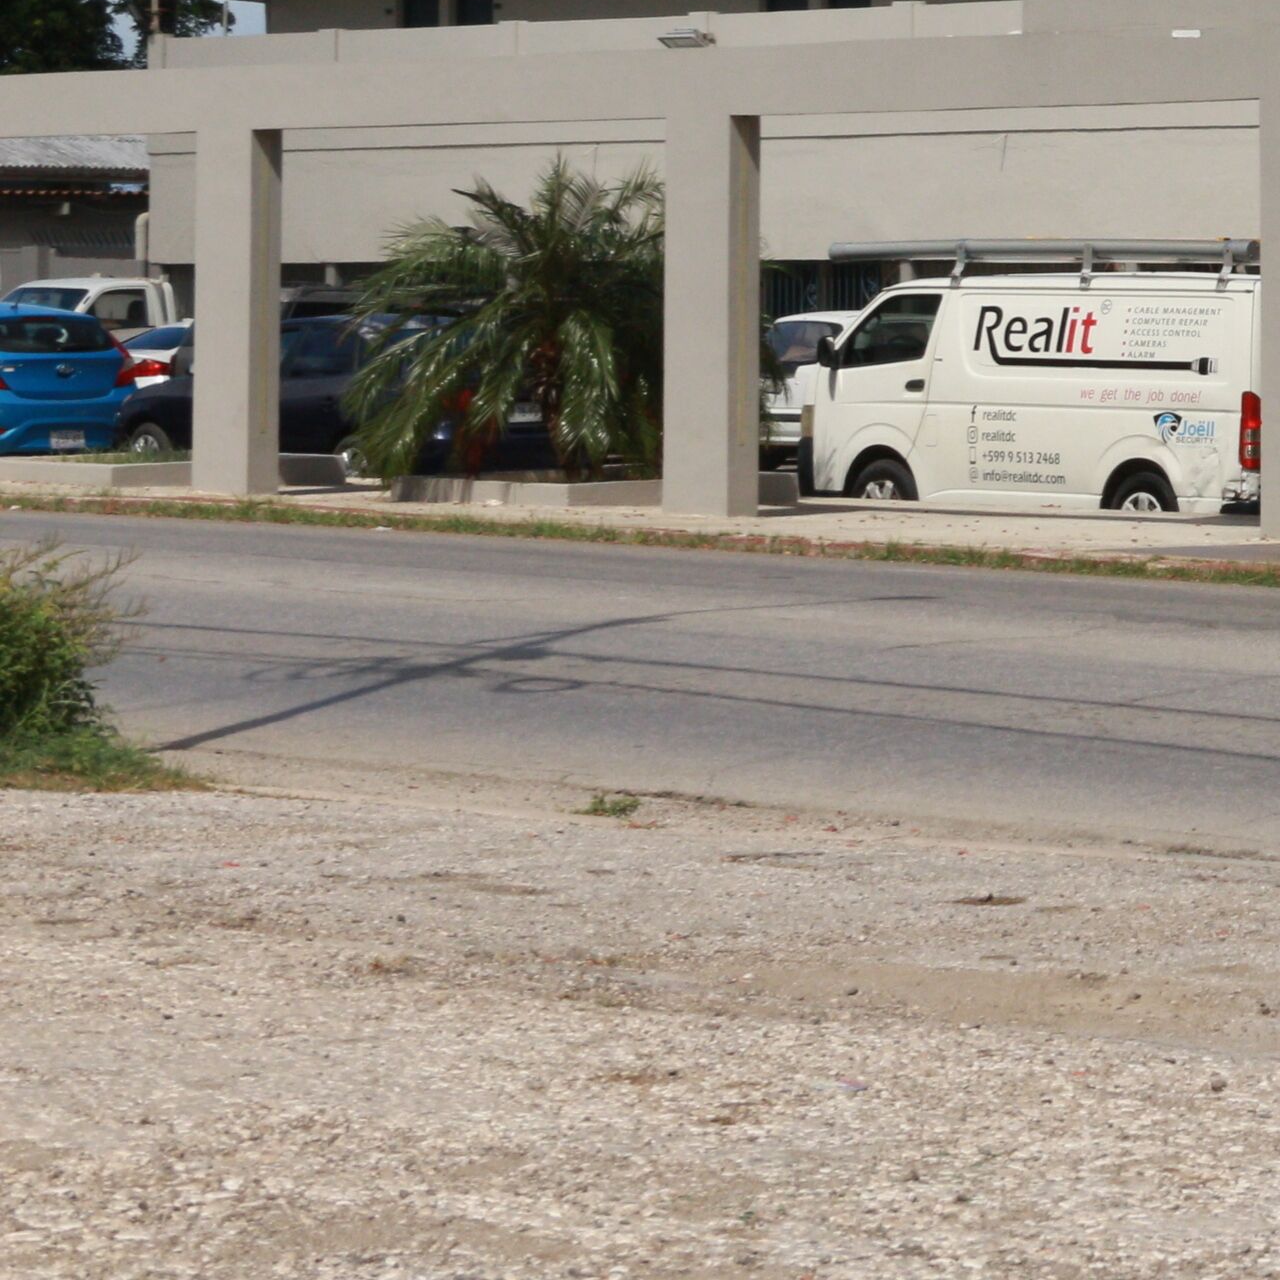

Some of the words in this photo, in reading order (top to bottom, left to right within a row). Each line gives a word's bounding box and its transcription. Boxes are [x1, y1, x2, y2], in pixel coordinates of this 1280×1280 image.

[1134, 306, 1160, 315] CABLE
[1162, 307, 1223, 316] MANAGEMENT
[1131, 317, 1177, 326] COMPUTER
[1178, 318, 1209, 327] REPAIR
[972, 305, 1098, 355] Realit
[1129, 328, 1160, 337] ACCESS
[1162, 329, 1202, 338] CONTROL
[1128, 339, 1168, 348] CAMERAS
[1126, 350, 1156, 359] ALARM
[1080, 388, 1095, 400] we
[1099, 387, 1118, 403] get
[1124, 388, 1142, 401] the
[1145, 389, 1165, 404] job
[1170, 390, 1202, 404] done!
[982, 409, 1017, 422] realitdc
[1177, 419, 1215, 437] Joëll
[981, 430, 1016, 442] realitdc
[1175, 436, 1214, 445] SECURITY
[982, 450, 1006, 463] +599
[1007, 451, 1014, 463] 9
[1016, 451, 1034, 464] 513
[1036, 452, 1061, 465] 2468
[982, 469, 1066, 485] info@realitdc.com
